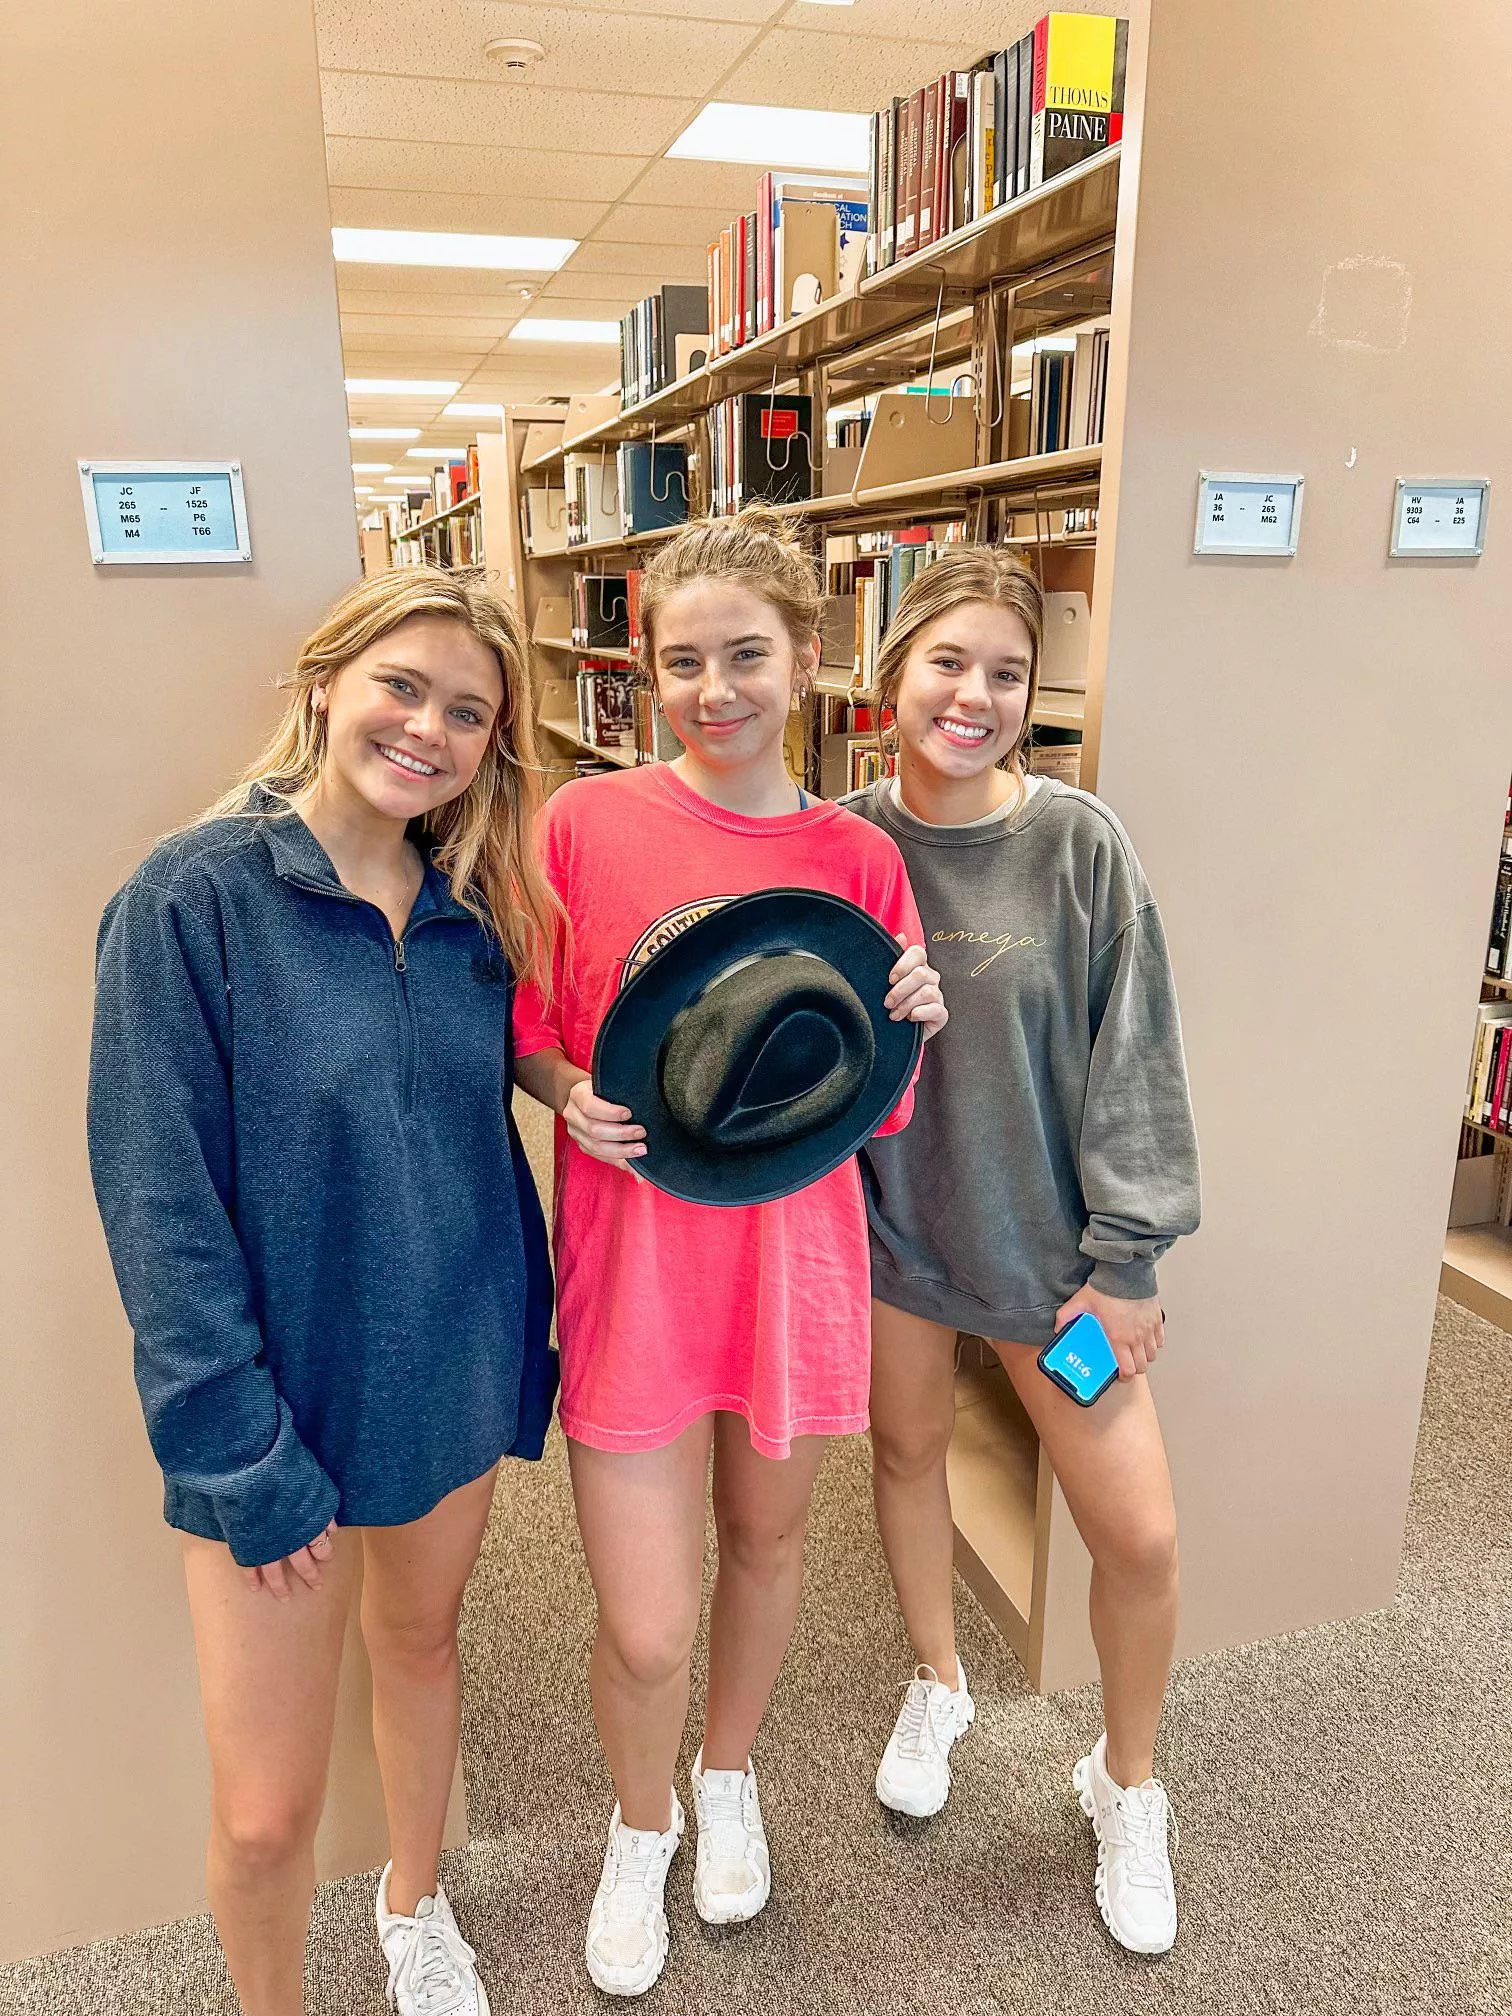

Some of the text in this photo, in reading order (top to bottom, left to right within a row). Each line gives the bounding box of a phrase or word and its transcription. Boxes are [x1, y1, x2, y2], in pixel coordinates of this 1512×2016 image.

[1034, 50, 1046, 113] THOMAS
[1049, 86, 1109, 109] THOMAS
[1047, 112, 1107, 142] PAINE
[120, 487, 133, 496] JC
[189, 486, 201, 495] JF
[1213, 493, 1224, 501] JA
[1264, 494, 1273, 502] JC
[119, 501, 137, 510] 265
[185, 500, 208, 508] 1525
[1213, 504, 1223, 512] 36
[1262, 505, 1276, 513] 265
[1406, 506, 1423, 514] 9303
[120, 514, 141, 523] M65
[193, 513, 206, 522] P6
[1212, 514, 1225, 522] M4
[1260, 515, 1278, 524] M62
[1407, 516, 1420, 524] C64
[1453, 516, 1466, 525] E25
[125, 529, 141, 538] M4
[192, 527, 211, 536] T66
[931, 929, 1048, 977] omega
[1065, 1351, 1092, 1378] 9:18
